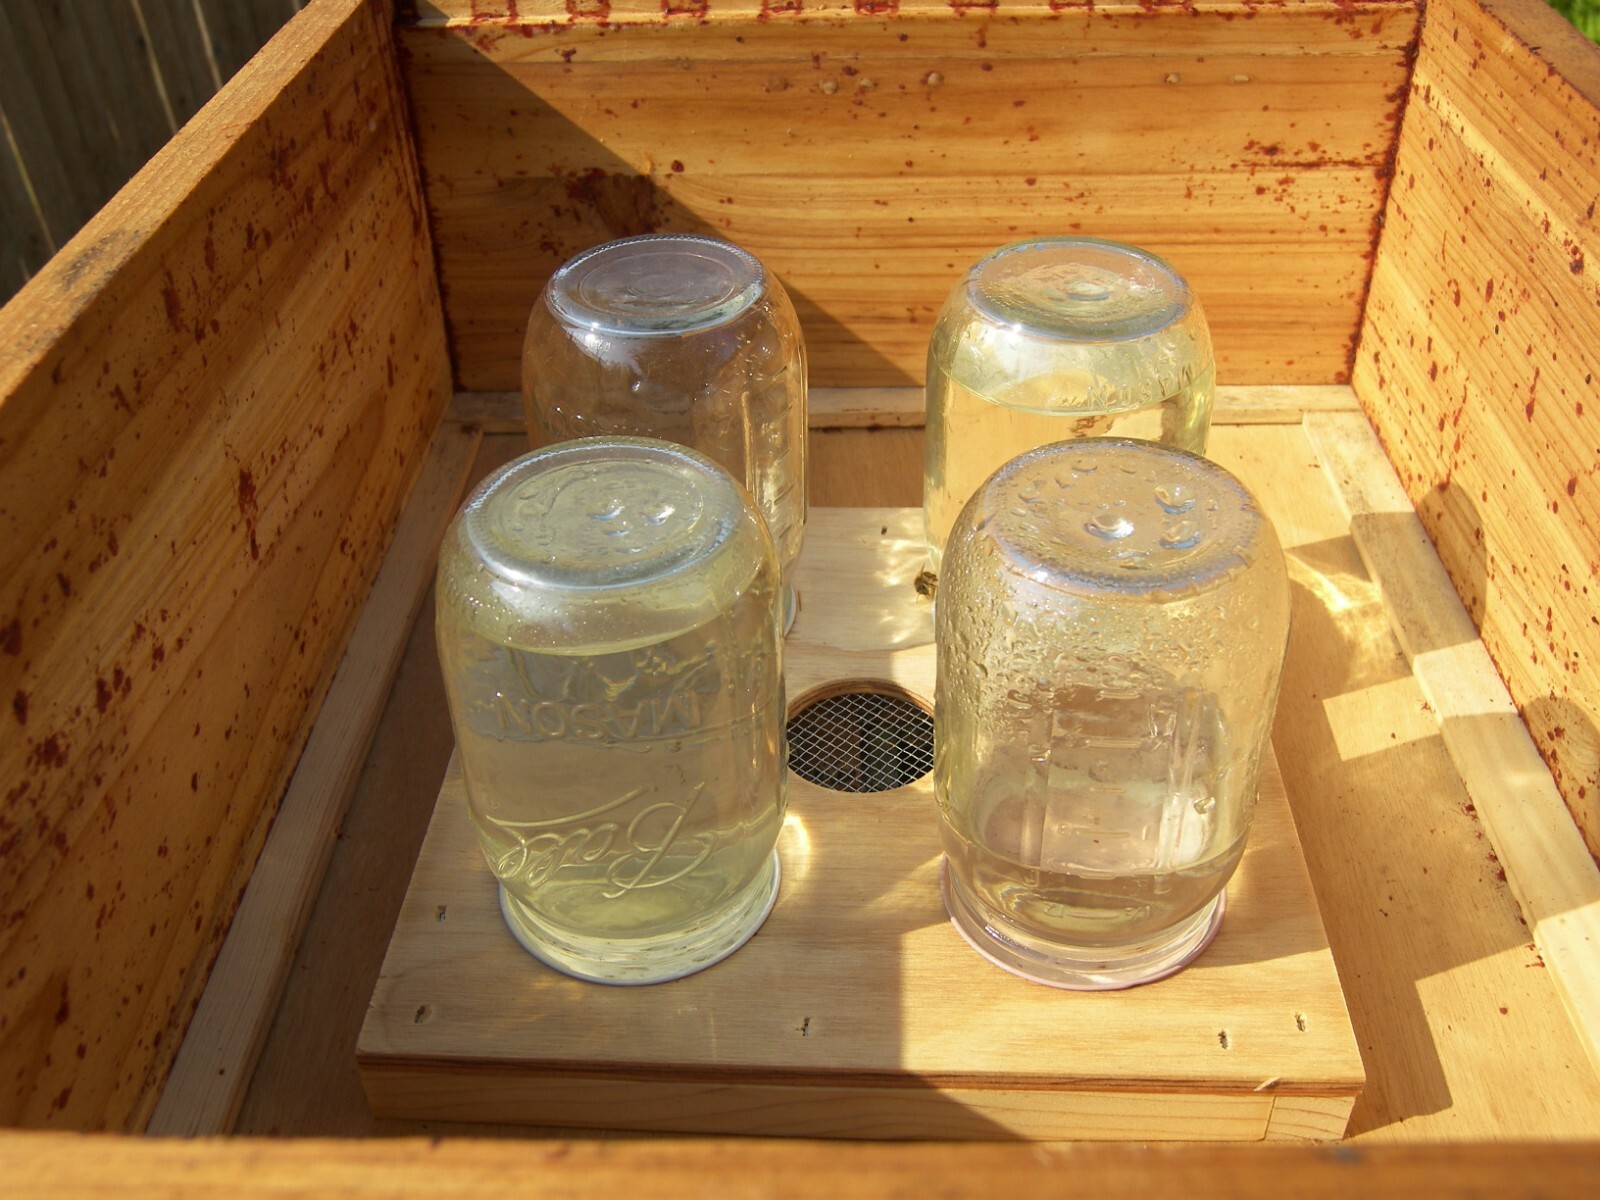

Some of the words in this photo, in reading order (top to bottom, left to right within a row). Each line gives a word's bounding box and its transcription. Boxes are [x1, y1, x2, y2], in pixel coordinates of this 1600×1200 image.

[1086, 364, 1193, 411] MASON
[497, 689, 701, 738] MASON
[486, 780, 718, 899] Ball
